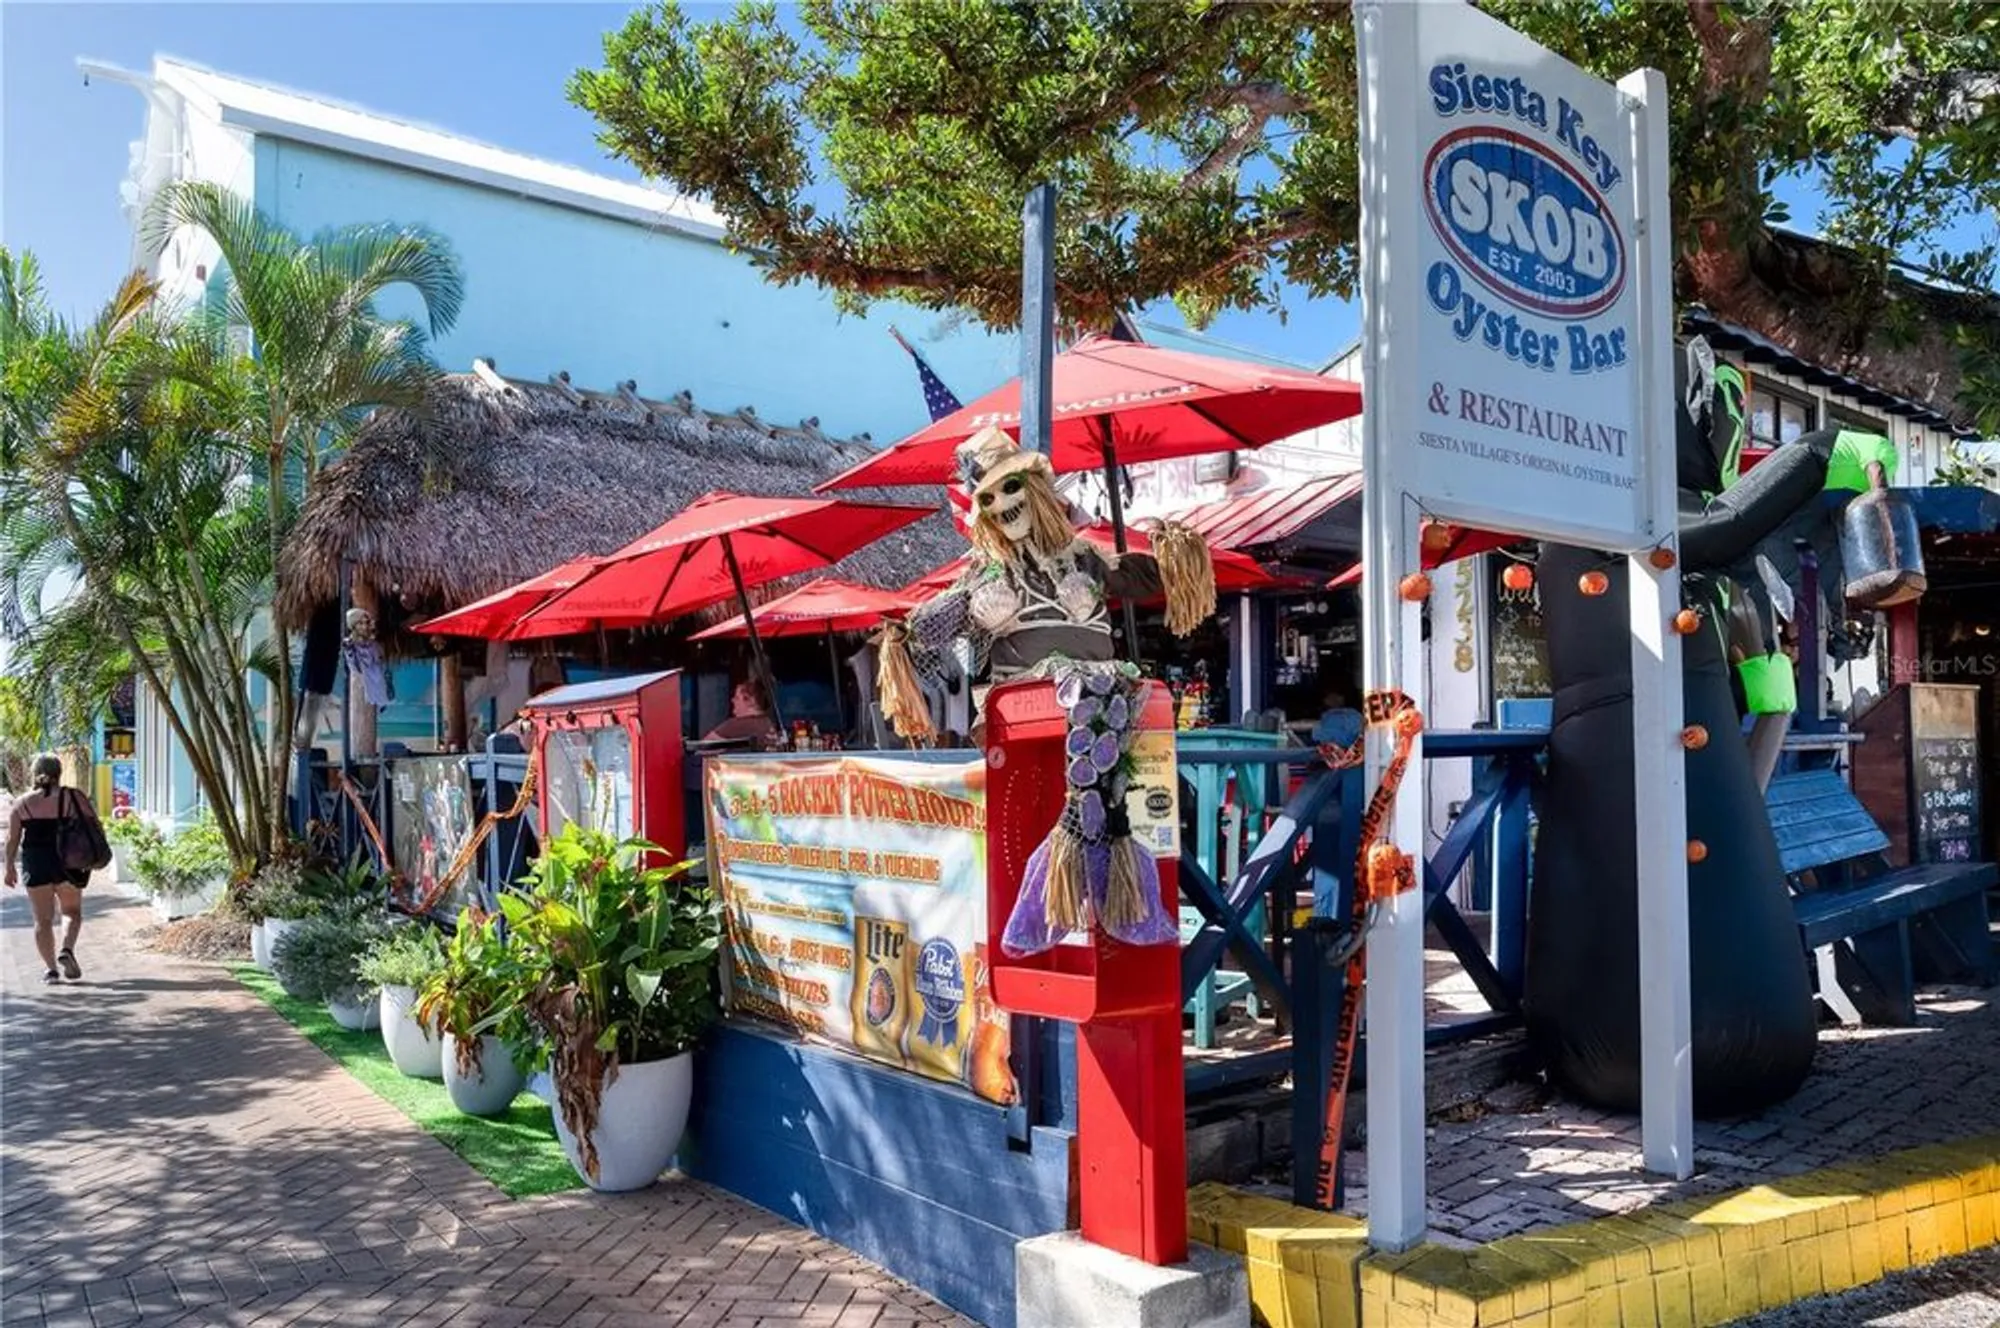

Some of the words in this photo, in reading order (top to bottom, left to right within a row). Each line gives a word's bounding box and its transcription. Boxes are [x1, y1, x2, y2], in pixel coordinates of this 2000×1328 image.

[1429, 63, 1547, 131] Siesta
[1556, 97, 1621, 192] Key
[1451, 158, 1608, 280] SKOB
[1534, 264, 1576, 294] 2003
[1427, 261, 1559, 370] Oyster
[1566, 325, 1626, 373] Bar
[969, 384, 1198, 429] Buweiser
[1428, 381, 1450, 416] &
[1458, 388, 1628, 457] RESTAURANT
[1419, 431, 1459, 453] SIESTA
[1522, 453, 1573, 477] ORIGINAL
[1573, 465, 1612, 485] OYSTER
[779, 774, 843, 816] ROCKIN'
[848, 773, 912, 822] POWER
[866, 921, 904, 963] Lite
